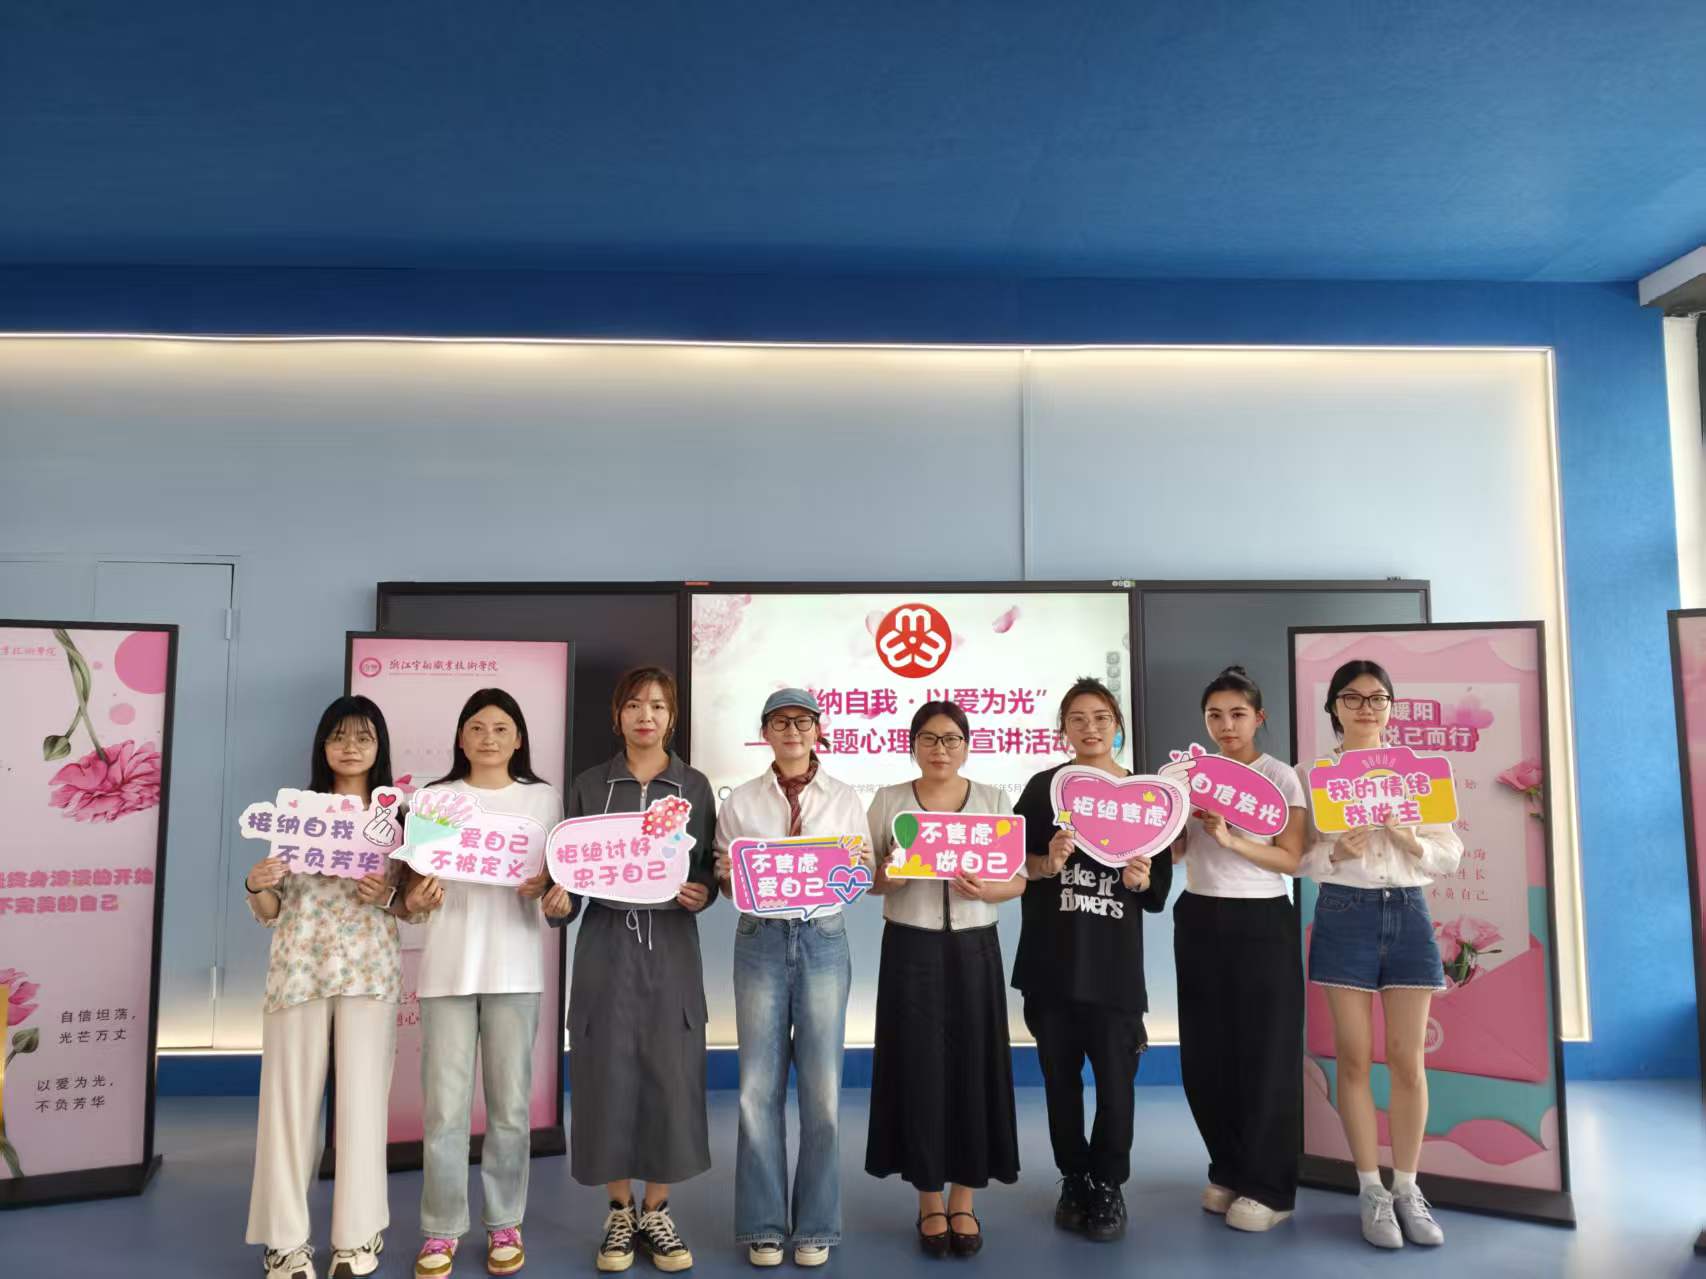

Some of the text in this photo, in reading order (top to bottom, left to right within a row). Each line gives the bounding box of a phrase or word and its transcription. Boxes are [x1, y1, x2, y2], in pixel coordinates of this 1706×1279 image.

[1191, 772, 1282, 827] 自信发光
[1326, 773, 1432, 801] 我的情绪
[247, 811, 354, 841] 接纳自我
[1072, 796, 1168, 828] 拒绝焦虑
[1344, 801, 1422, 827] 我做主
[460, 827, 529, 855] 爱自己
[921, 822, 993, 846] 不焦虑
[277, 843, 381, 873] 不负芳华
[556, 836, 650, 864] 拒绝讨好
[751, 853, 818, 875] 不焦虑
[936, 849, 1009, 874] 做自己
[430, 850, 525, 879] 不被定义
[574, 860, 667, 889] 忠于自己
[757, 876, 824, 899] 爱自己
[59, 1028, 127, 1044] 光芒万丈
[35, 1095, 105, 1113] 不负芳华
